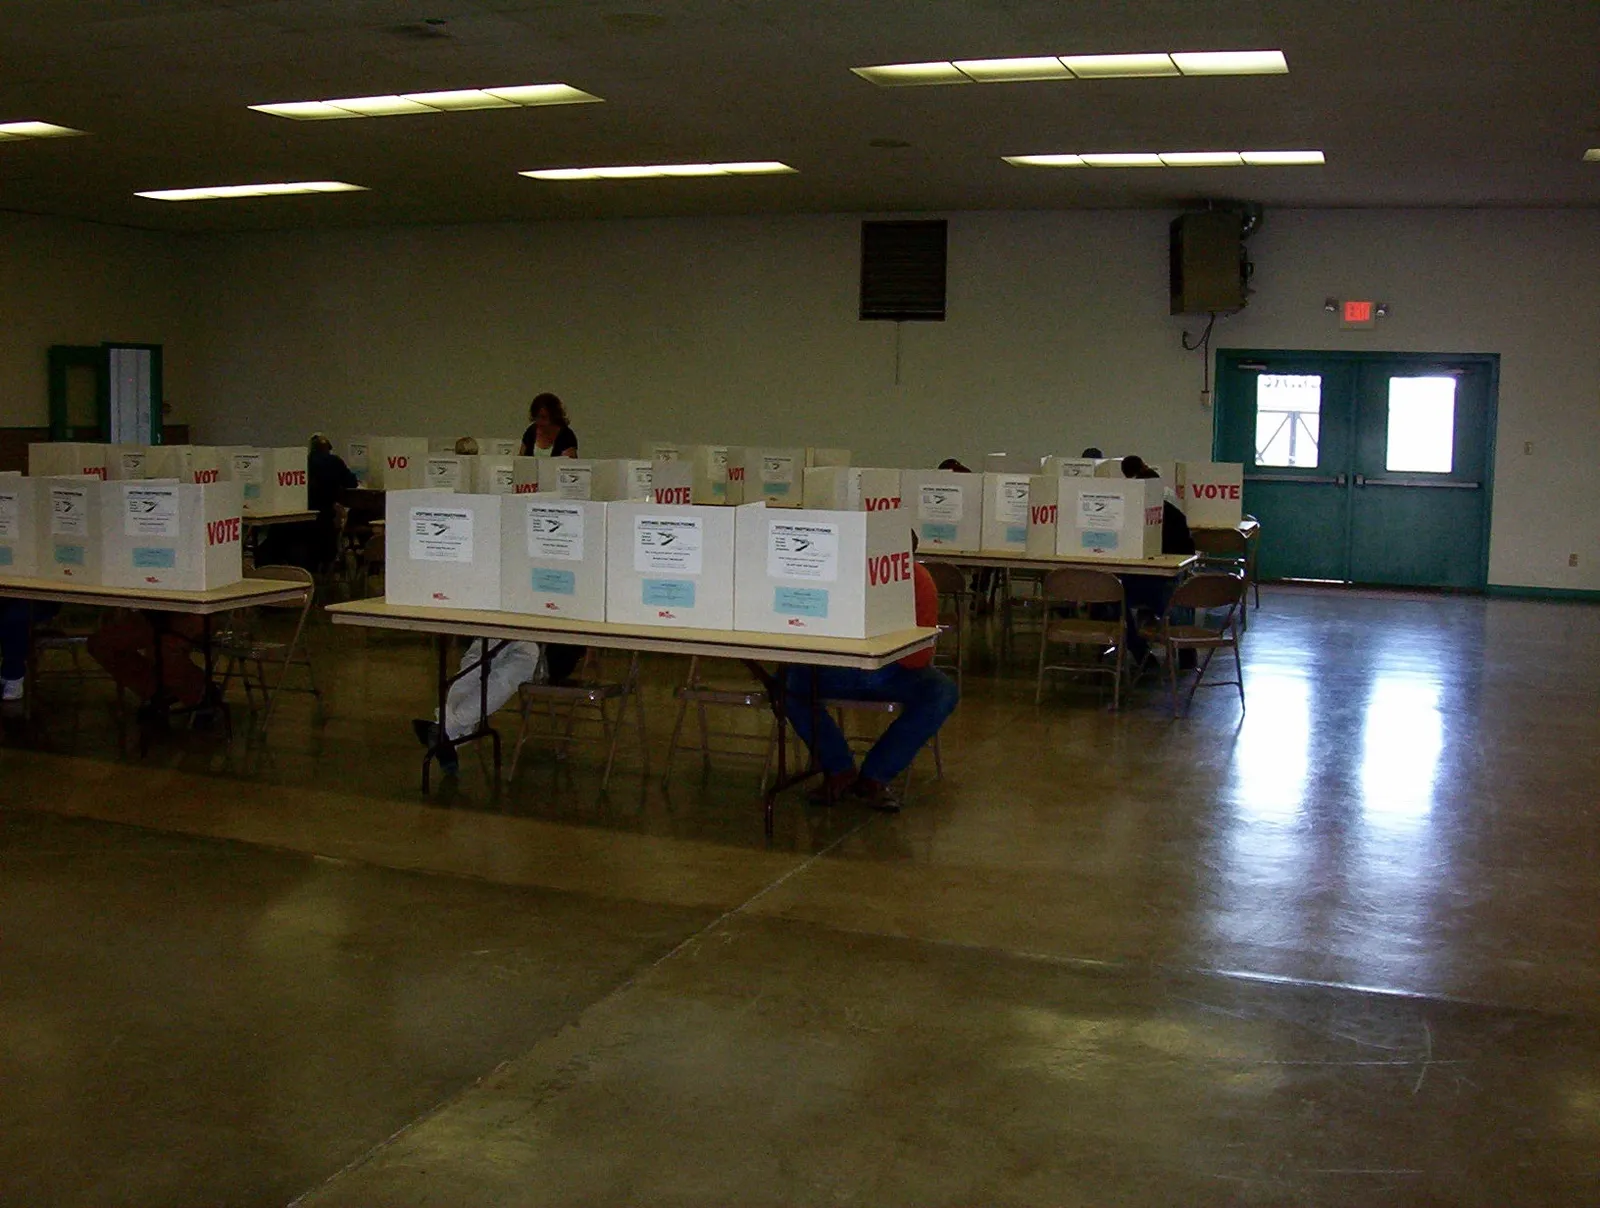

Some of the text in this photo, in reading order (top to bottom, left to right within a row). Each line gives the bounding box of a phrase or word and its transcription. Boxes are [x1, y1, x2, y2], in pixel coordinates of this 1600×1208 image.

[387, 456, 410, 469] VO
[278, 471, 305, 486] VOTE
[655, 487, 691, 504] VOTE
[1192, 484, 1240, 499] VOTE
[1032, 505, 1057, 525] VOT
[207, 517, 240, 546] VOTE
[869, 552, 911, 586] VOTE
